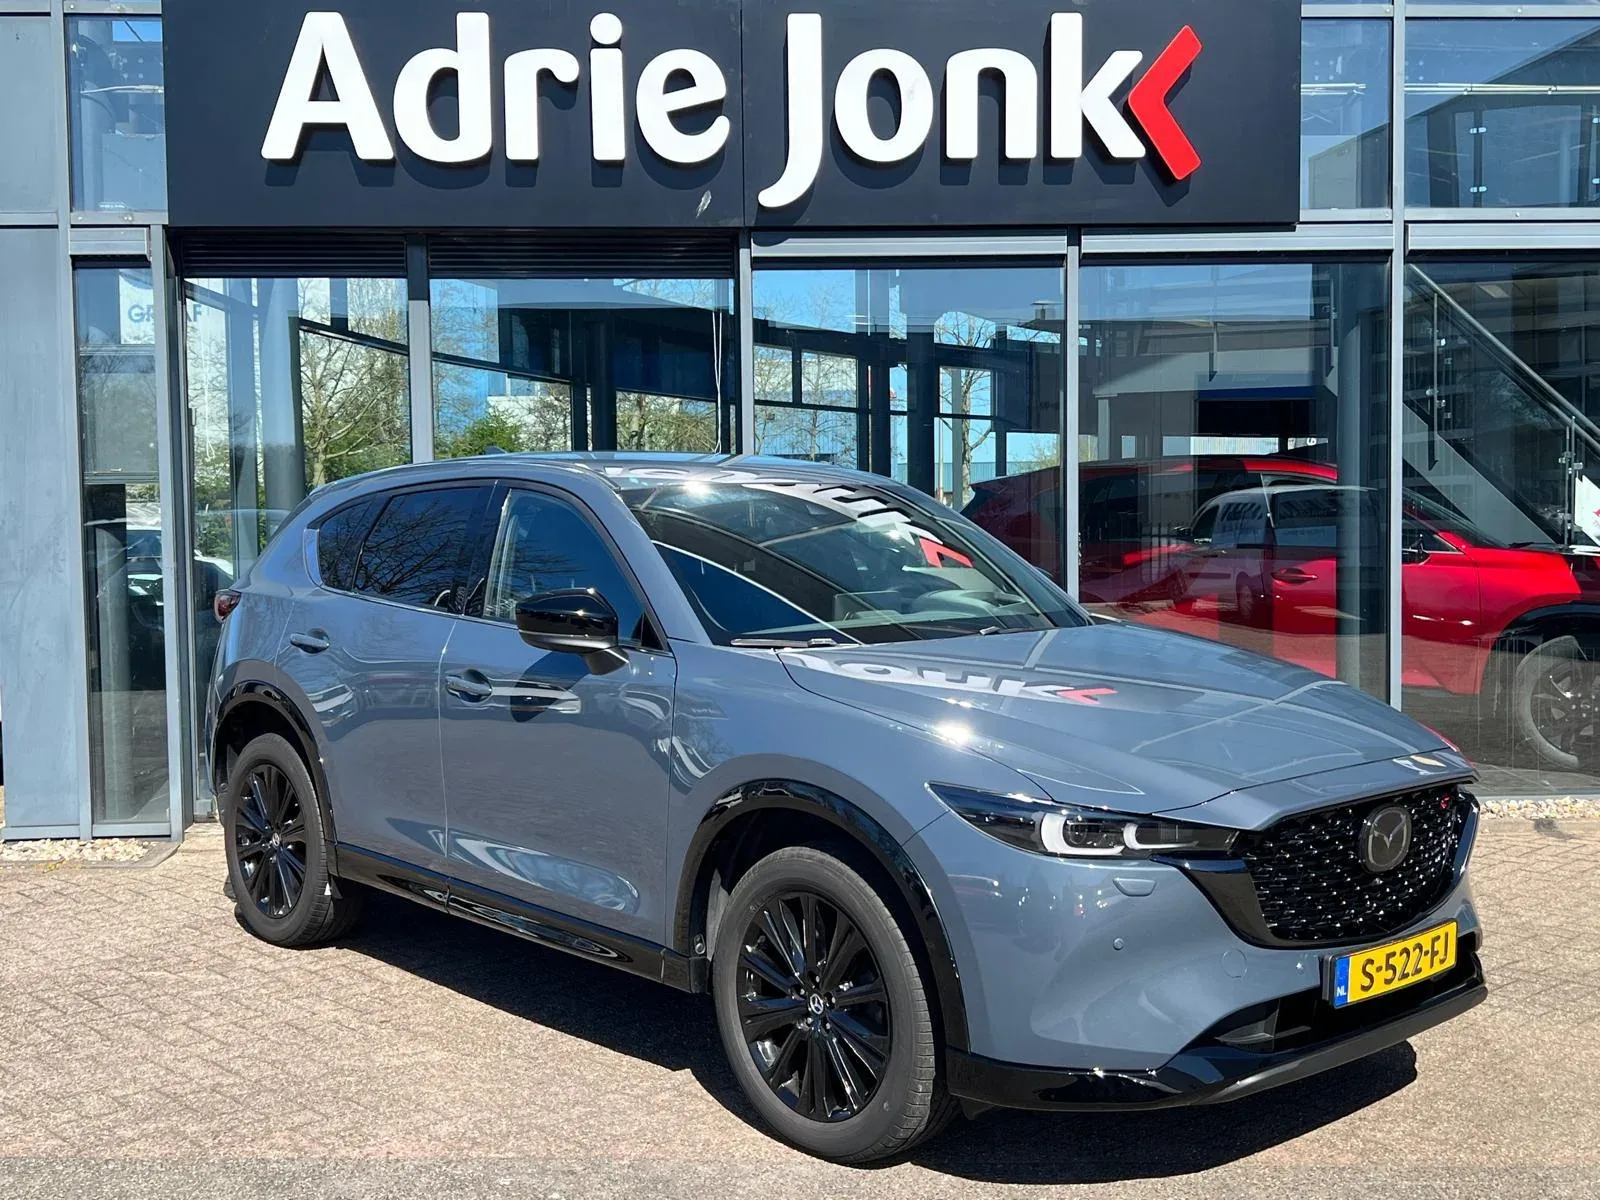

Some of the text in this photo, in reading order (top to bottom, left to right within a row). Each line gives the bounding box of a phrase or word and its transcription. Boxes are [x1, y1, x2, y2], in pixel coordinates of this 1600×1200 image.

[261, 11, 1147, 208] Adrie Jonk
[1336, 985, 1347, 997] NL
[1360, 931, 1449, 993] S-522-FJ
